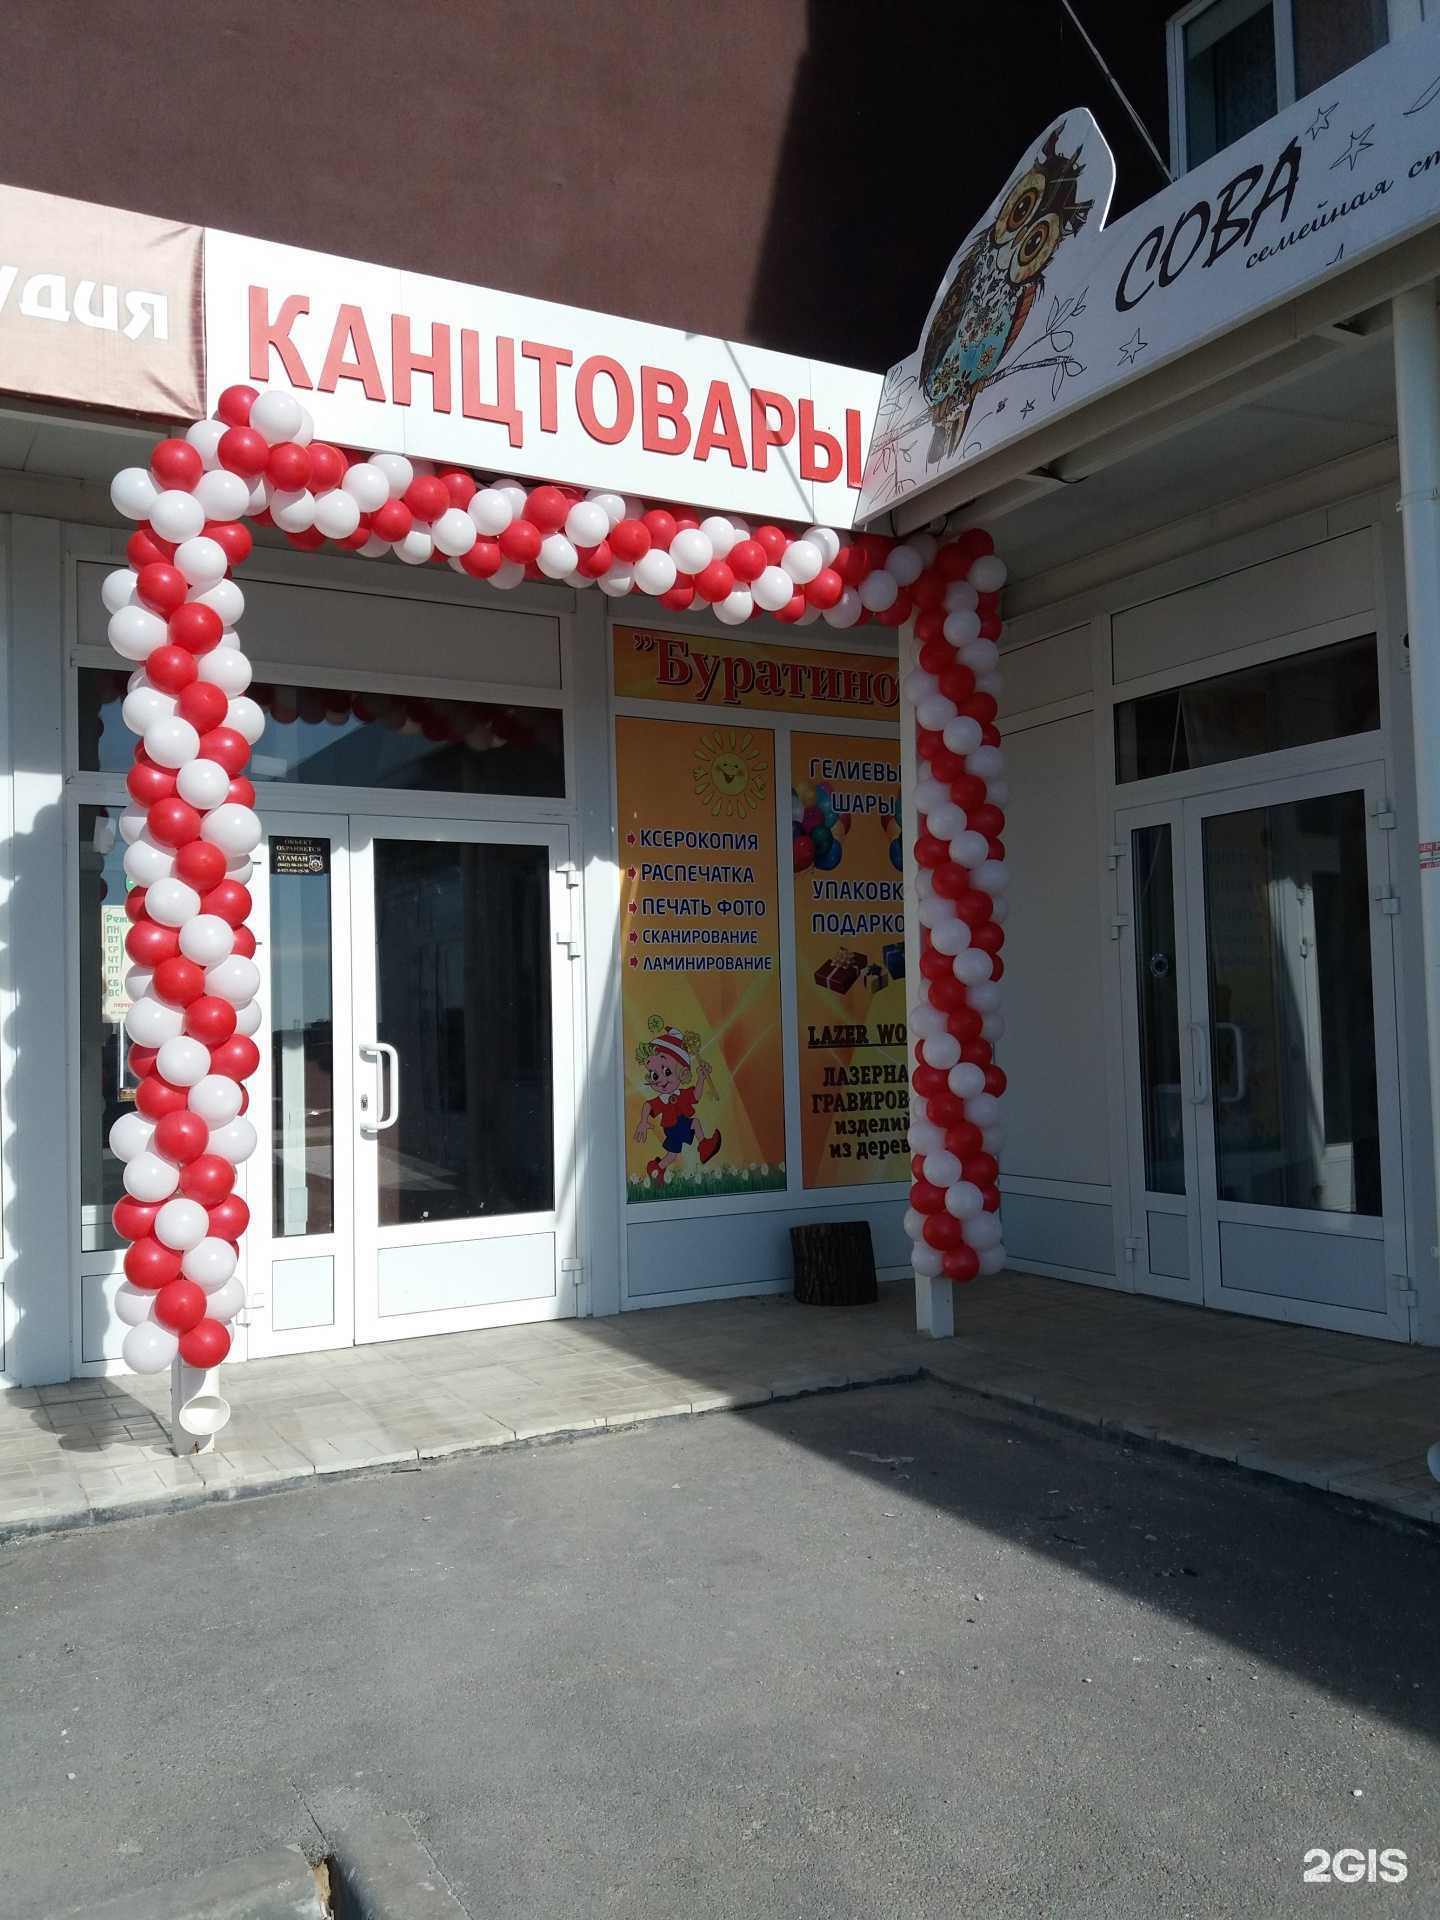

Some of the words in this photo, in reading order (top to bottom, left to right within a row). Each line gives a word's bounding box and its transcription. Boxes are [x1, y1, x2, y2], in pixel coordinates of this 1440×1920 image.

[1115, 136, 1301, 311] СОВА
[1246, 180, 1393, 268] семейная
[248, 284, 862, 489] КАНЦТОВАРЫ
[832, 793, 894, 814] ШАРЫ
[640, 830, 758, 850] КСЕРОКОПИЯ
[641, 864, 754, 883] РАСПЕЧАТКА
[642, 898, 712, 915] ПЕЧАТЬ
[717, 900, 766, 916] ФОТО
[642, 930, 758, 944] СКАНИРОВАНИЕ
[643, 957, 772, 970] ЛАМИНИРОВАНИЕ
[808, 1025, 870, 1046] LAZER
[823, 1065, 908, 1087] ЛАЗЕРНА
[829, 1143, 852, 1158] из
